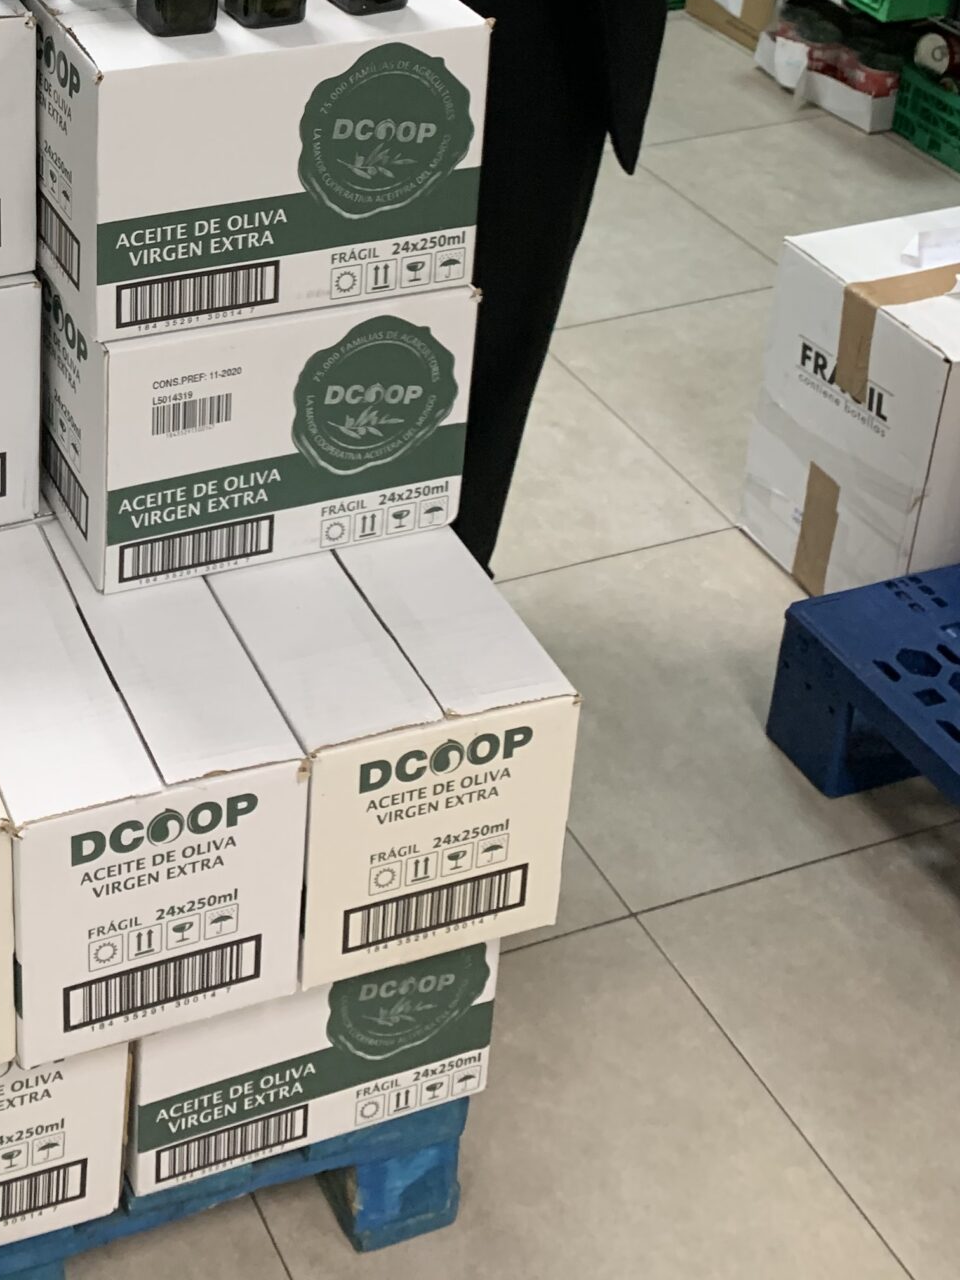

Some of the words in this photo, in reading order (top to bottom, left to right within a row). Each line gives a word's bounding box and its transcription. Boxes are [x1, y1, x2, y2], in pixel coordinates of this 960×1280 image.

[332, 118, 437, 143] DCOOP
[116, 223, 188, 249] ACEITE
[195, 217, 221, 235] DE
[227, 209, 287, 231] OLIVA
[128, 240, 203, 267] VIRGEN
[210, 230, 274, 254] EXTRA
[331, 246, 379, 264] FRÁGIL
[392, 231, 466, 254] 24x250ml
[209, 367, 242, 378] 11-2020
[801, 342, 887, 422] FRIL
[152, 390, 193, 404] L5014319
[324, 382, 423, 405] DCOOP
[118, 487, 186, 514] ACEITE
[194, 482, 218, 499] DE
[224, 469, 281, 494] OLIVA
[131, 503, 200, 529] VIRGEN
[207, 489, 268, 514] EXTRA
[321, 499, 367, 517] FRÁGIL
[379, 481, 449, 506] 24x250ml
[359, 726, 533, 794] DCOOP
[366, 787, 427, 812] ACEITE
[433, 780, 455, 795] DE
[461, 768, 511, 789] OLIVA
[377, 801, 439, 825] VIRGEN
[445, 786, 499, 809] EXTRA
[71, 793, 258, 867] DCOOP
[370, 844, 420, 865] FRÁGIL
[433, 818, 510, 849] 24x250ml
[80, 858, 146, 886] ACEITE
[152, 850, 176, 866] DE
[182, 836, 236, 858] OLIVA
[92, 871, 159, 898] VIRGEN
[167, 855, 224, 880] EXTRA
[88, 917, 142, 939] FRÁGIL
[156, 888, 238, 920] 24x250ml
[11, 1071, 64, 1091] OLIVA
[413, 1052, 482, 1082] 24x250ml
[156, 1092, 222, 1123] ACEITE
[229, 1083, 254, 1099] DE
[260, 1063, 316, 1089] OLIVA
[168, 1102, 237, 1134] VIRGEN
[244, 1082, 303, 1111] EXTRA
